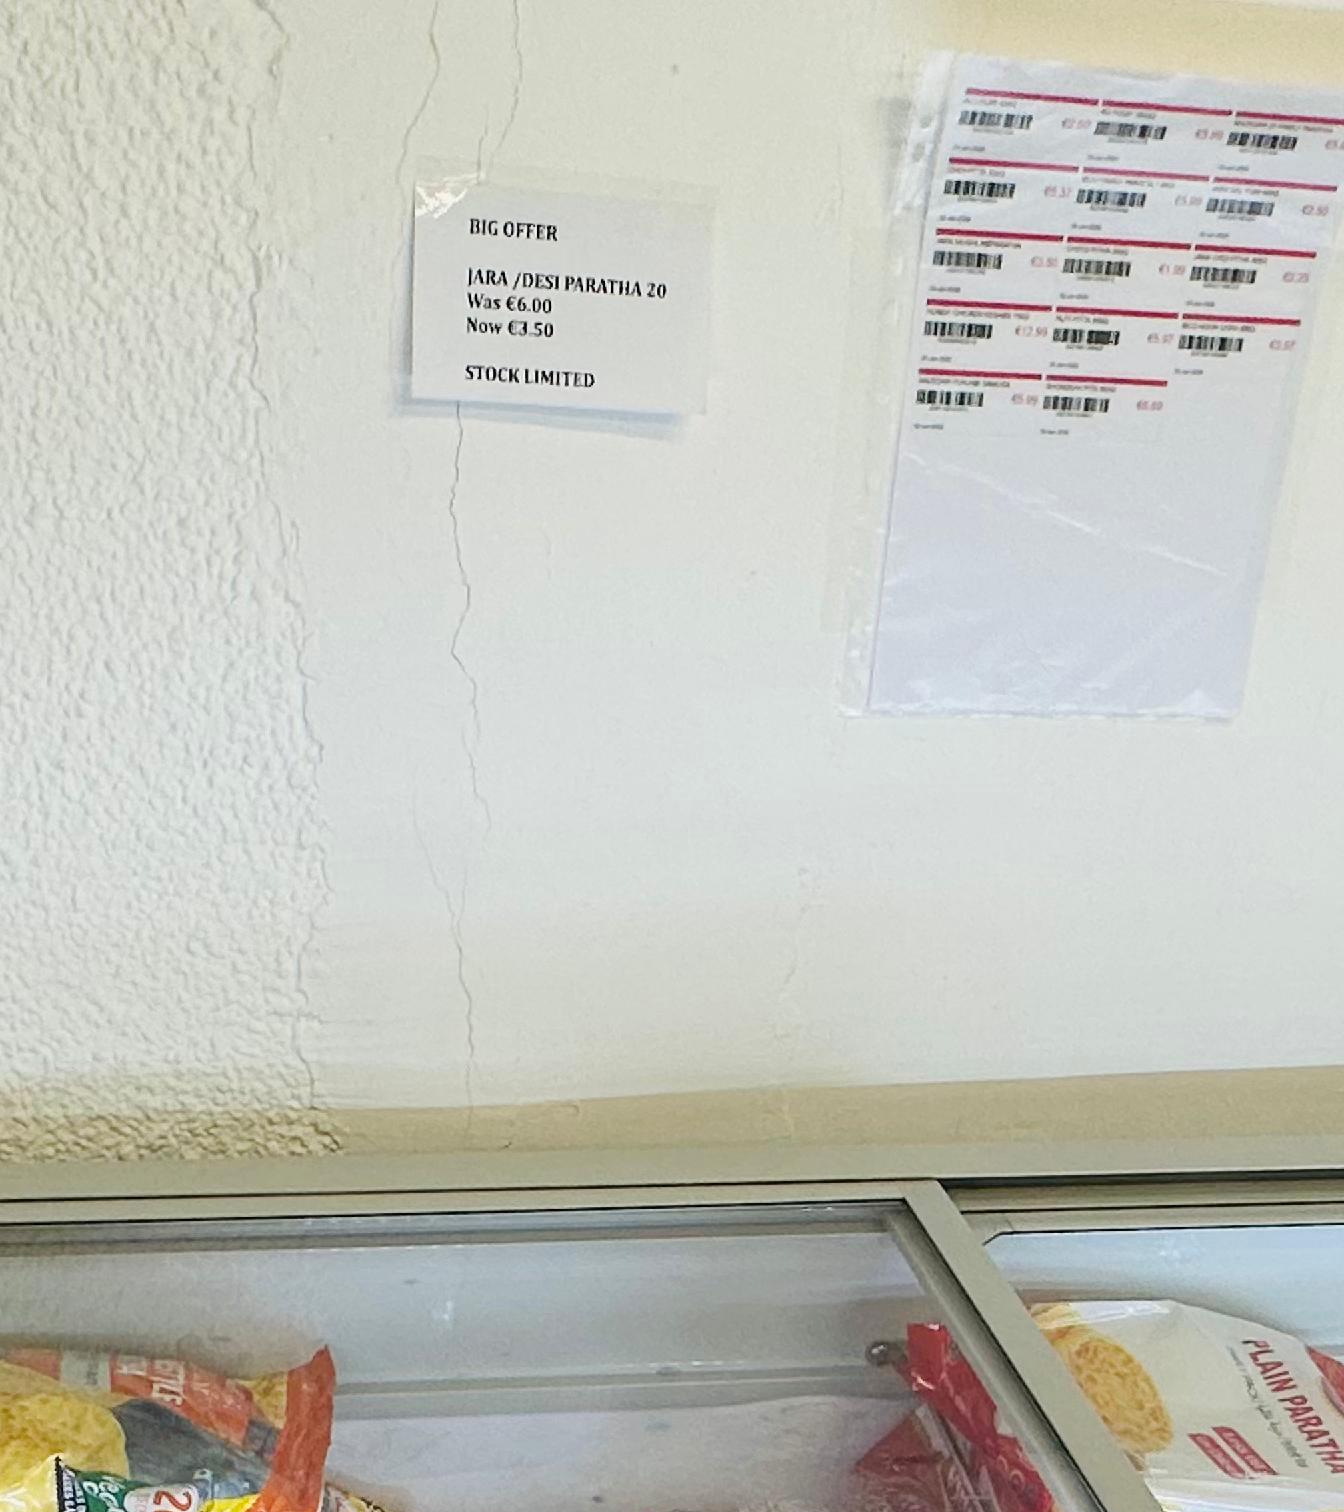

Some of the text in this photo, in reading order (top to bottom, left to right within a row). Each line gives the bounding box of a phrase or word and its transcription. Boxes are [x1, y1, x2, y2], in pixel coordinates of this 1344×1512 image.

[469, 218, 558, 241] BIG OFFER
[468, 267, 507, 288] JARA
[565, 274, 642, 297] PARATHA
[647, 282, 666, 298] 20
[467, 293, 553, 313] Was €6.00
[467, 317, 554, 338] Now €3.50
[465, 365, 596, 388] STOCK LIMITED
[1242, 1340, 1297, 1393] PLAIN
